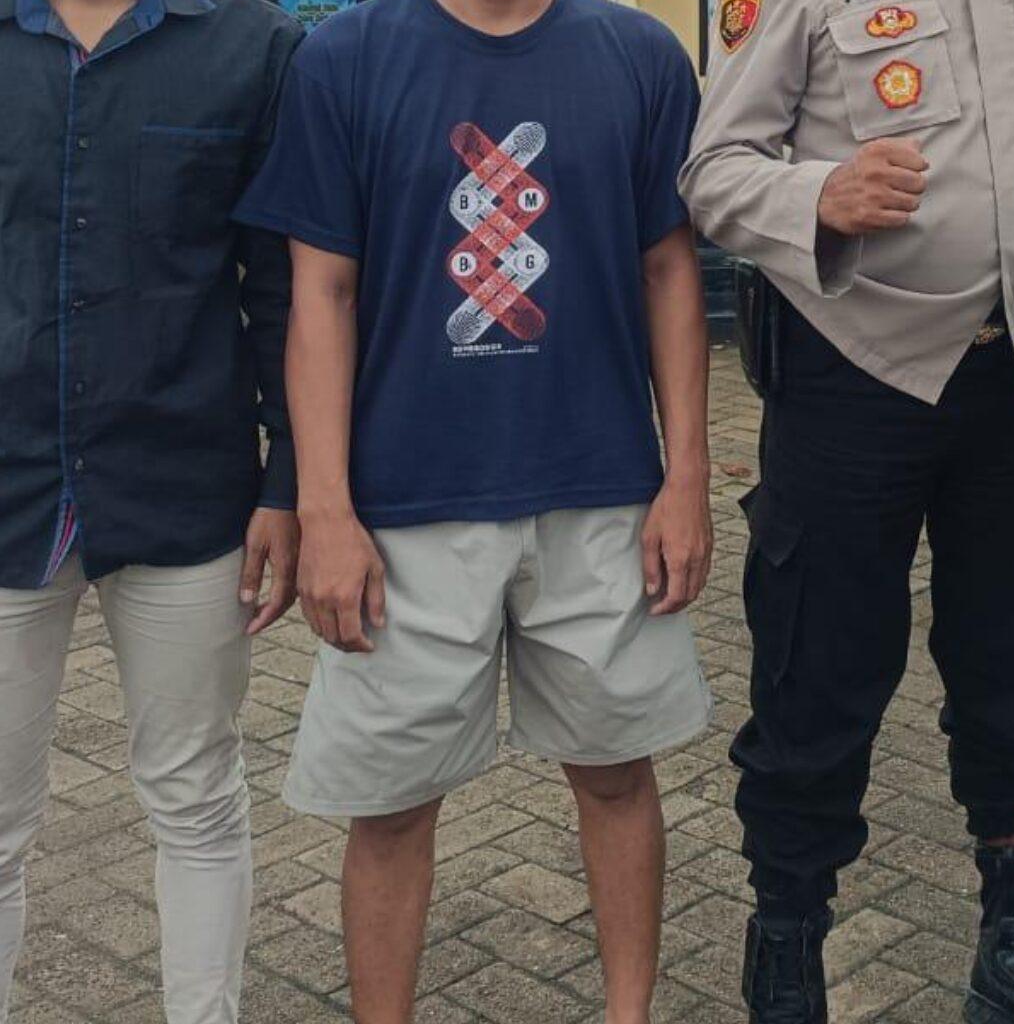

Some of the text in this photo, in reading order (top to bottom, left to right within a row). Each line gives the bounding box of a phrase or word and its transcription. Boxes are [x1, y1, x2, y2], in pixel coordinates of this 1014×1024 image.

[459, 193, 538, 210] B M
[459, 254, 535, 273] B G
